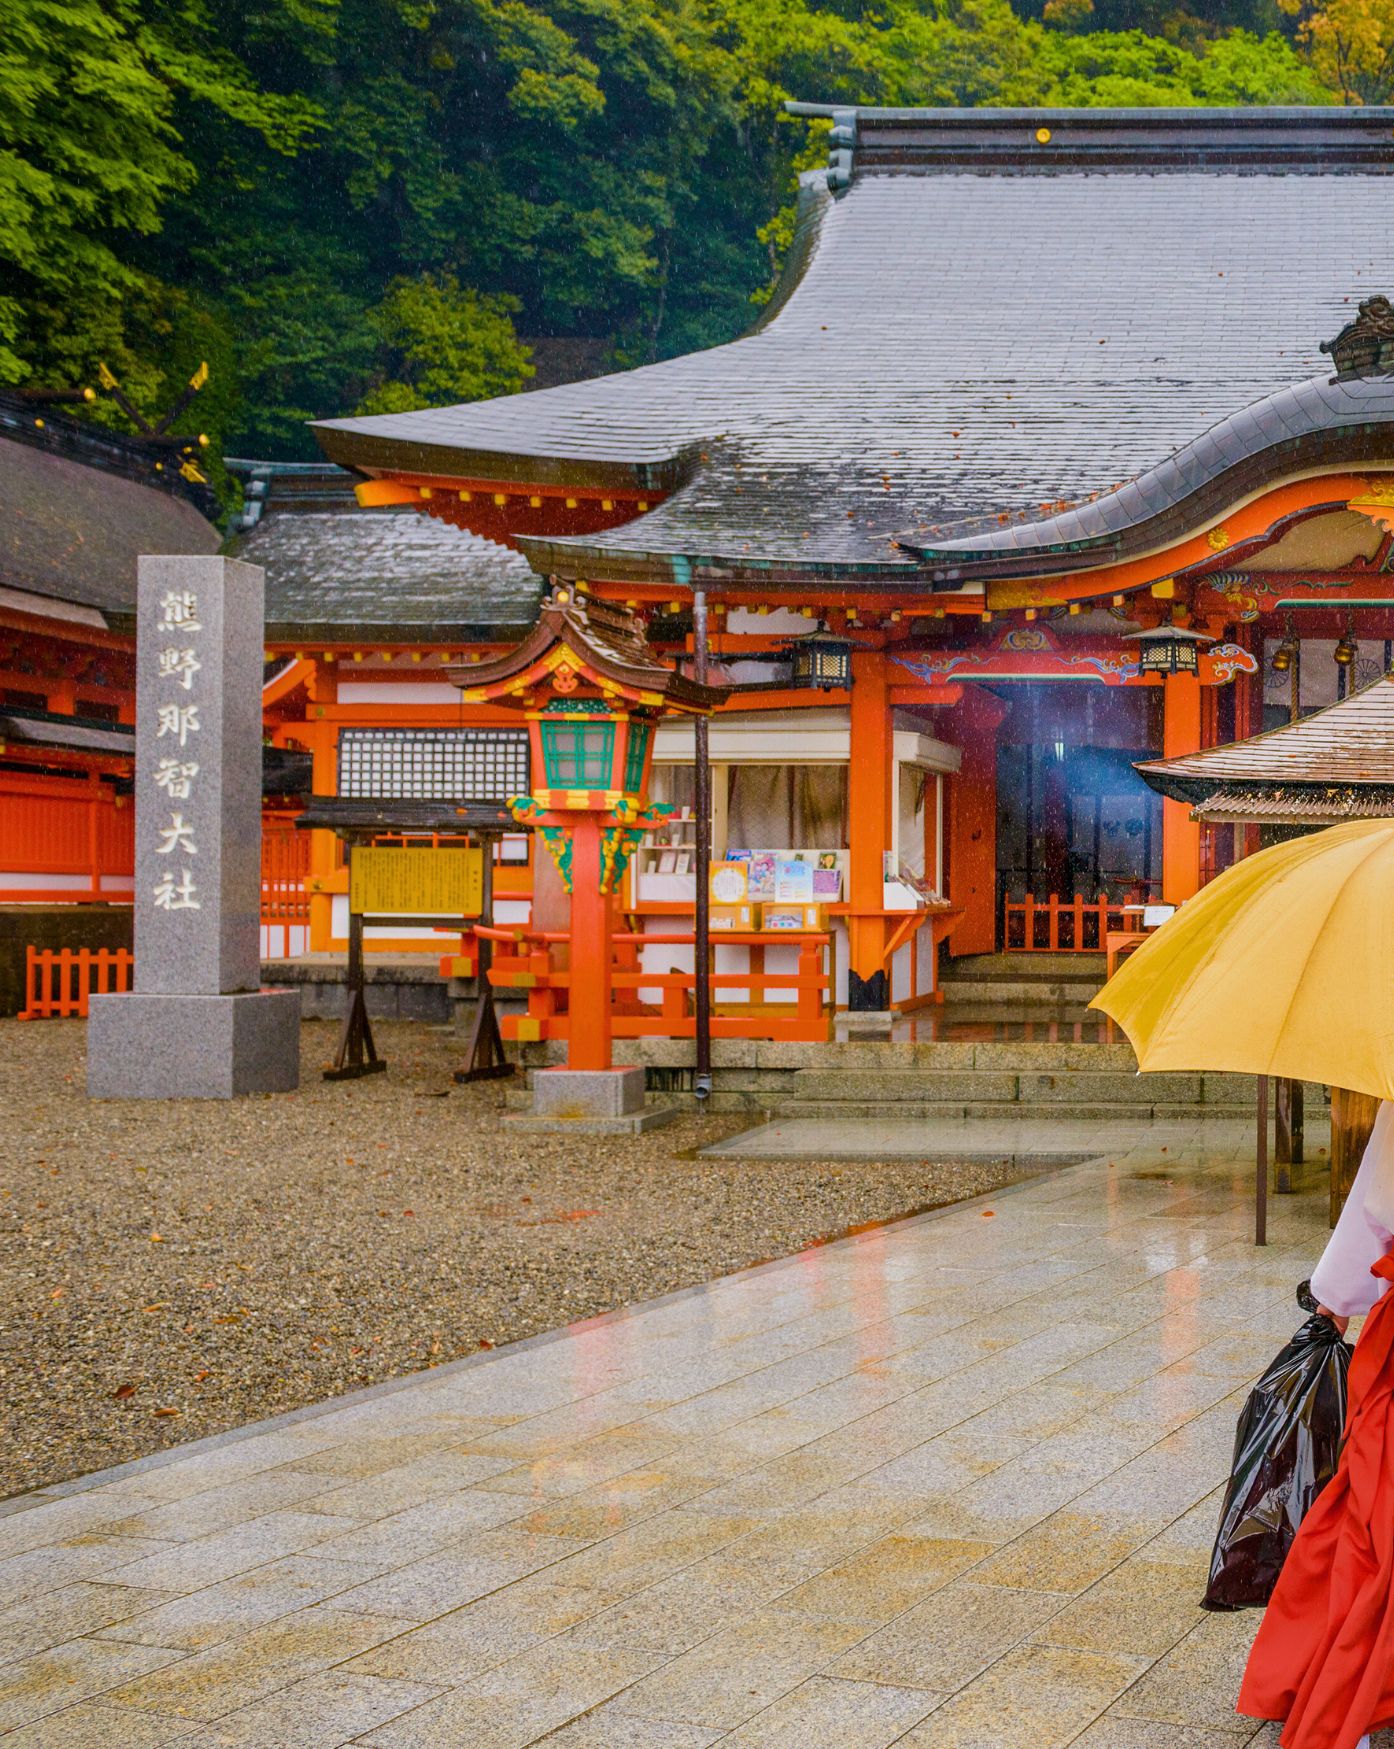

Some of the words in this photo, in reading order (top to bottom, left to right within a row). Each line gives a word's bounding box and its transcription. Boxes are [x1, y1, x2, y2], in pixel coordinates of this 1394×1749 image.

[153, 590, 202, 912] 熊野那智大社
